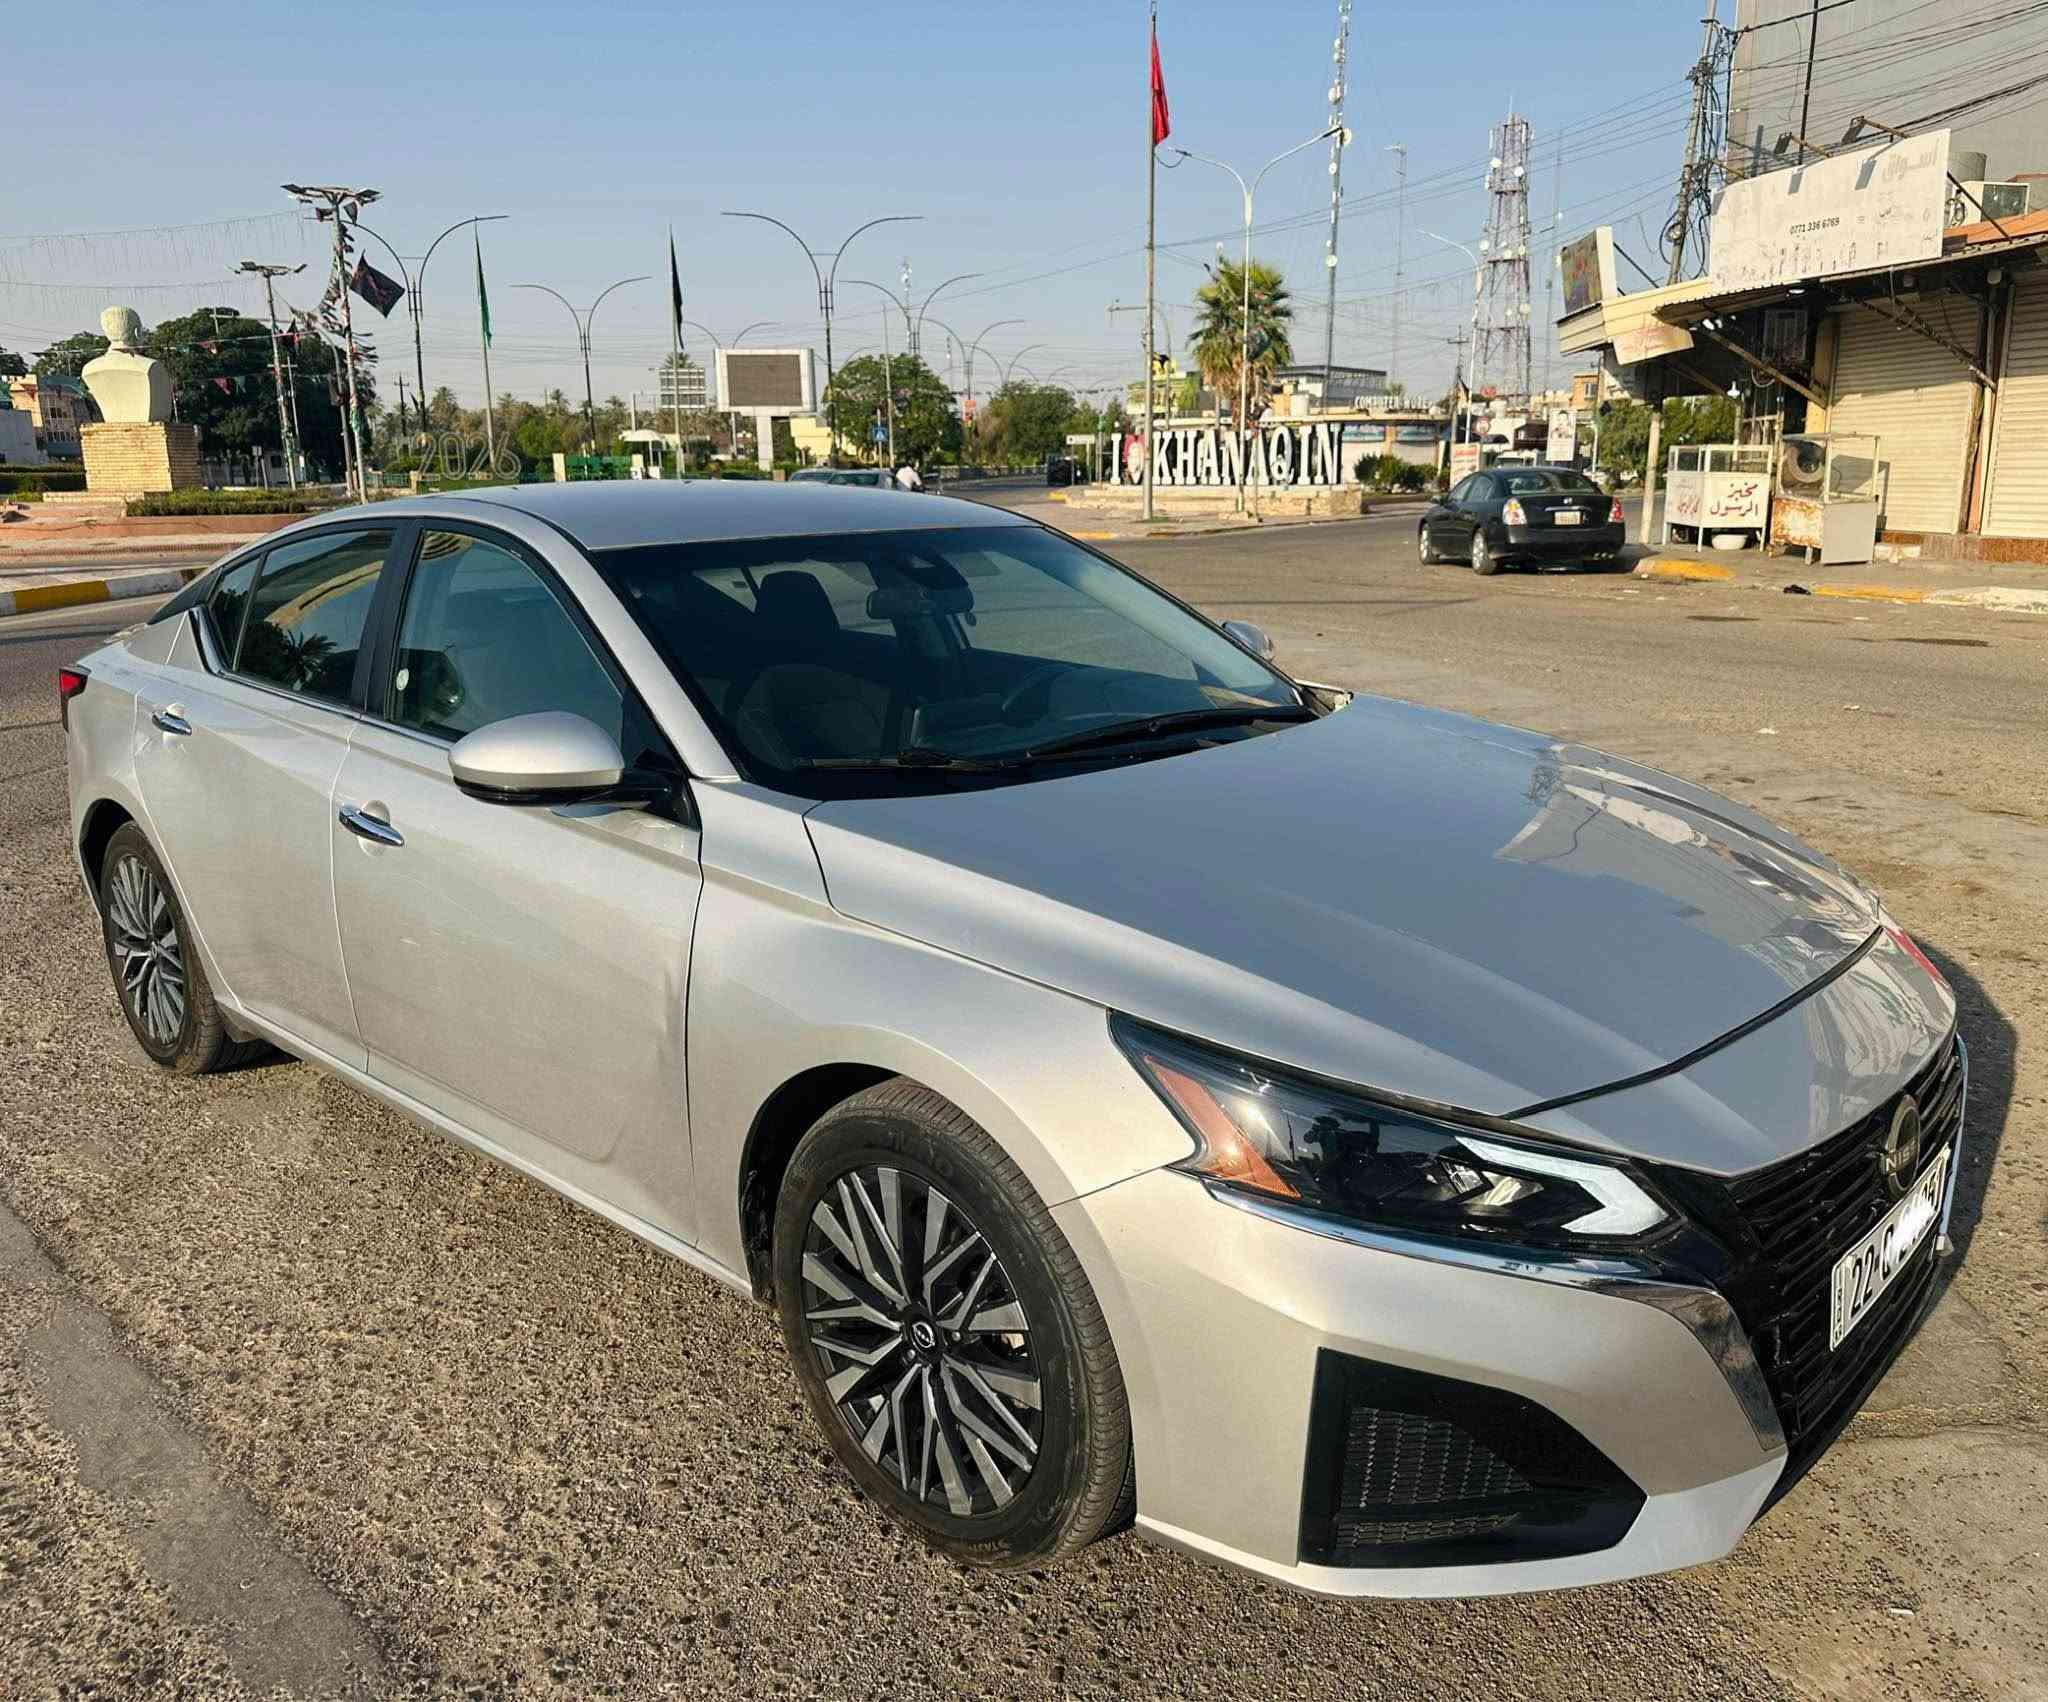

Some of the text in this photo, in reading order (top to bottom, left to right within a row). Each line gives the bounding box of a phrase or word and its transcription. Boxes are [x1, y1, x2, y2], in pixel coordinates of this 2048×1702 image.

[414, 431, 521, 480] 2026
[1152, 424, 1342, 486] KHANAQIN
[1726, 481, 1759, 500] مخبز
[1710, 499, 1759, 517] الرسول
